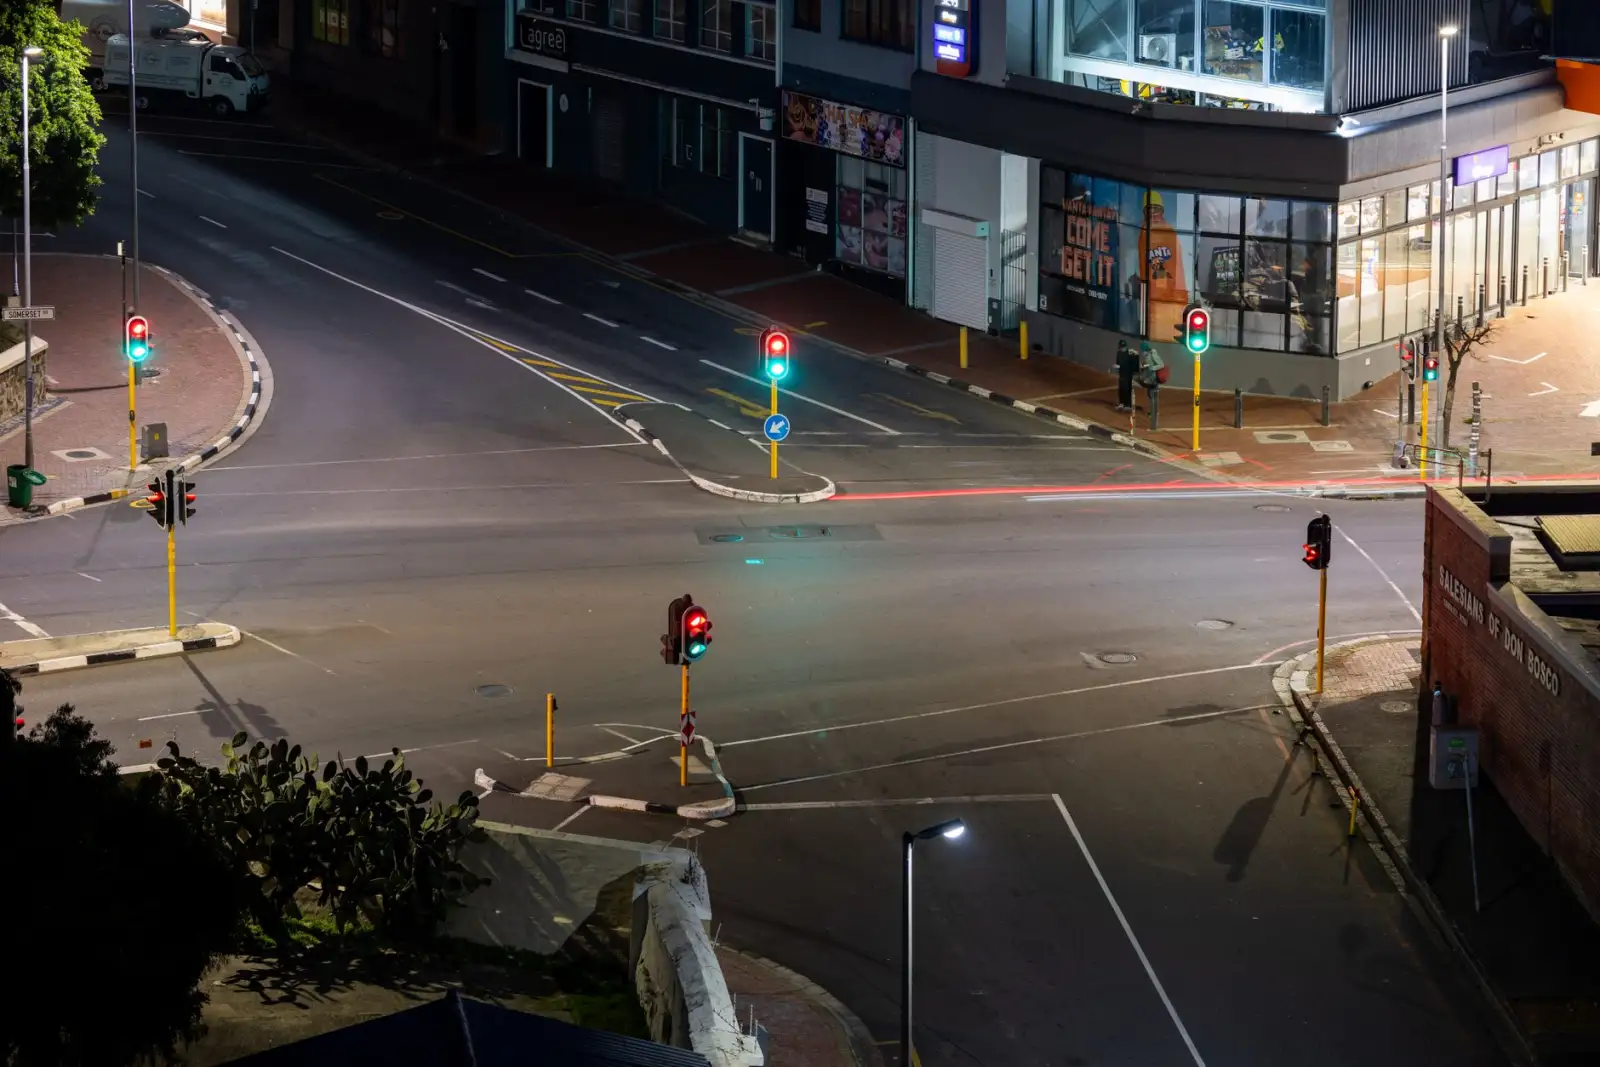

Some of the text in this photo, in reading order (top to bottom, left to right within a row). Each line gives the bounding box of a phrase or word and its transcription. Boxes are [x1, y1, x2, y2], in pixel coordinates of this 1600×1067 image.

[1067, 215, 1110, 253] COME
[1149, 246, 1172, 259] ANTA
[1061, 245, 1114, 288] GET IT
[8, 310, 41, 319] SOMERSET
[1439, 564, 1484, 625] SALESIANS
[1489, 612, 1501, 639] OF
[1504, 626, 1525, 663] DON
[1528, 648, 1560, 697] BOSCO
